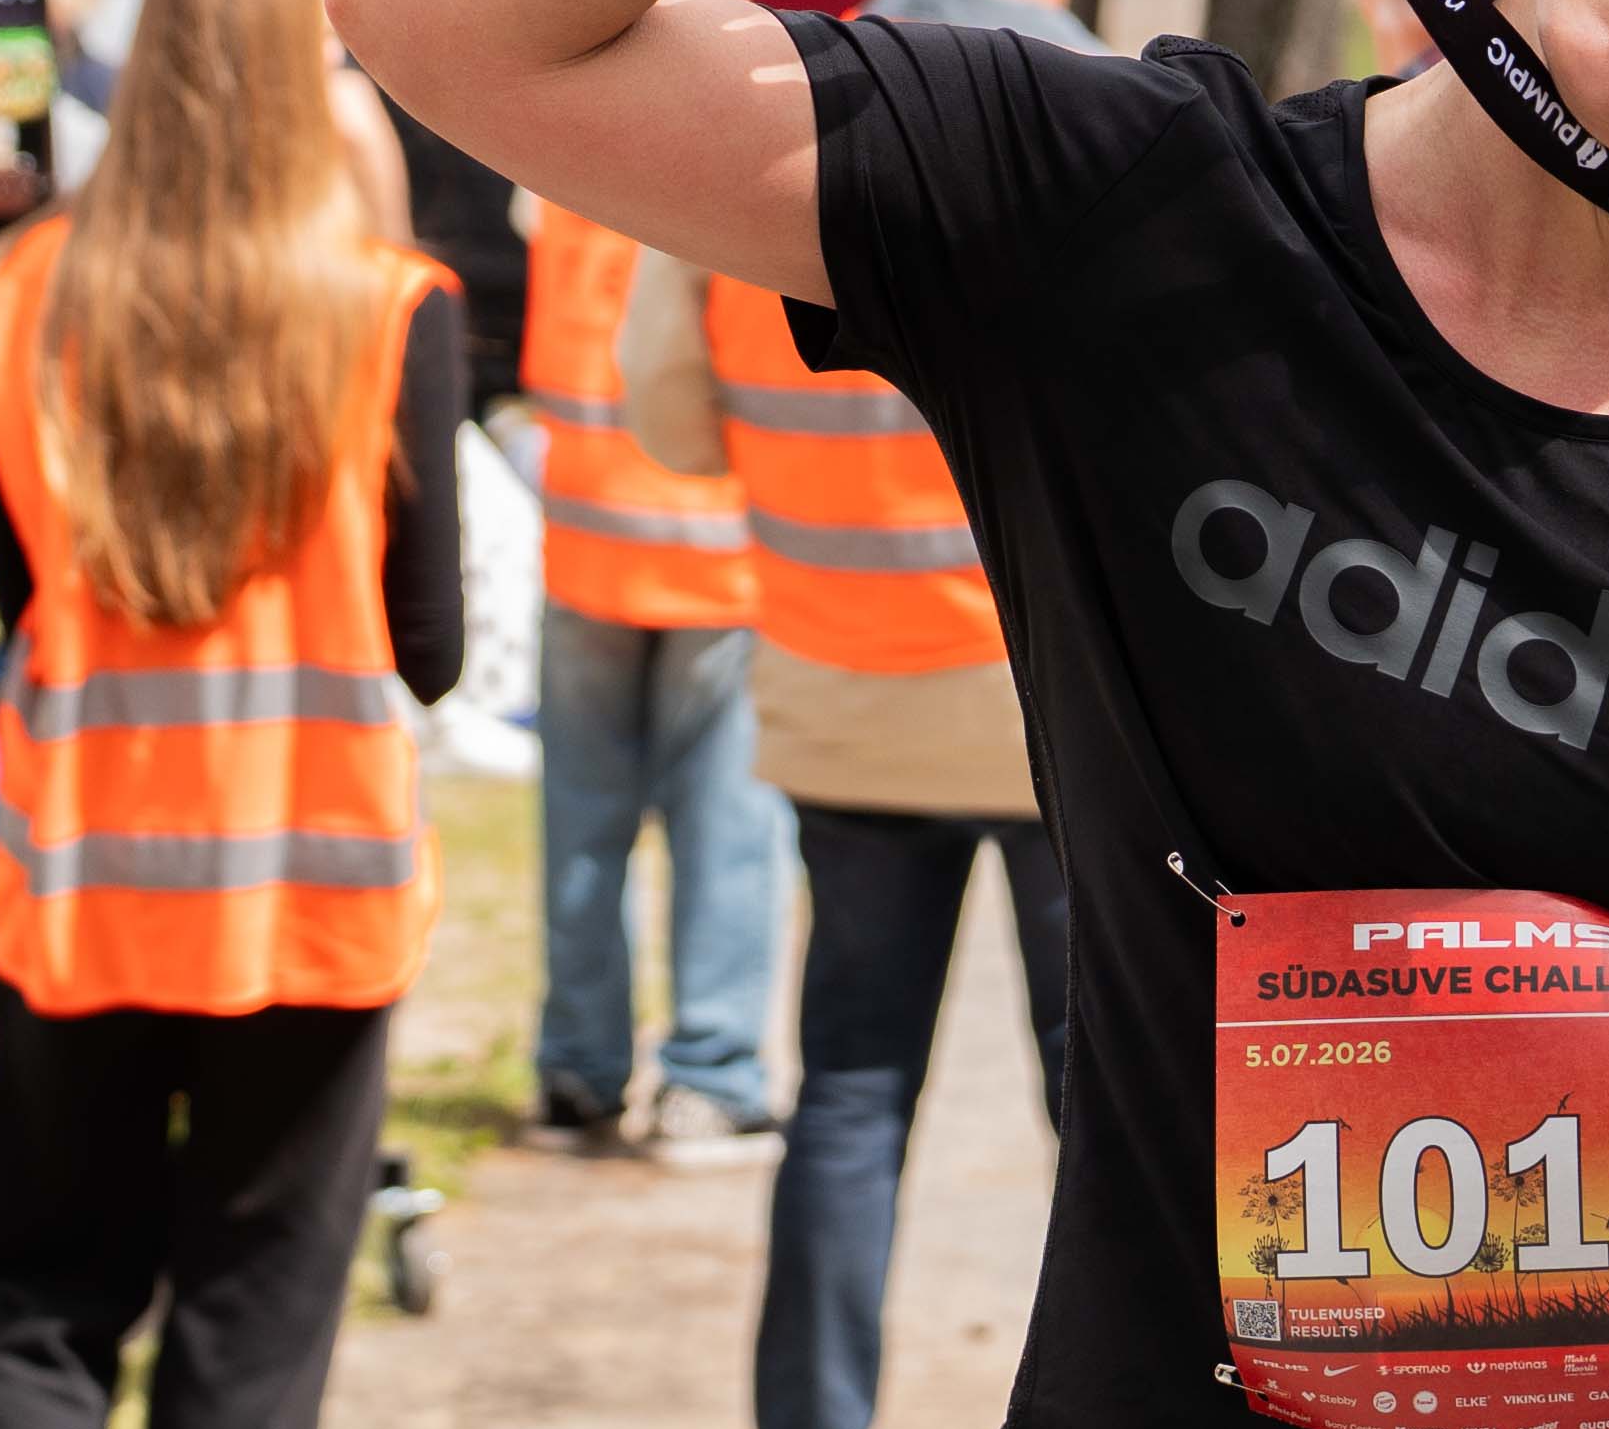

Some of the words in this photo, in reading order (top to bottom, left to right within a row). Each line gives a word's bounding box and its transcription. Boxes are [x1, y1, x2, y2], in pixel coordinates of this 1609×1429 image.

[1487, 37, 1581, 146] PUMPIC
[1257, 963, 1473, 1001] SÜDASUVE
[1245, 1040, 1392, 1068] 5.07.2026
[1288, 1307, 1386, 1321] TULEMUSED
[1290, 1325, 1359, 1338] RESULTS
[1393, 1364, 1451, 1375] SPORTLAND
[1318, 1393, 1357, 1408] Stebby
[1455, 1396, 1488, 1408] ELKE
[1503, 1394, 1546, 1405] VIKING
[1548, 1392, 1575, 1403] LINE
